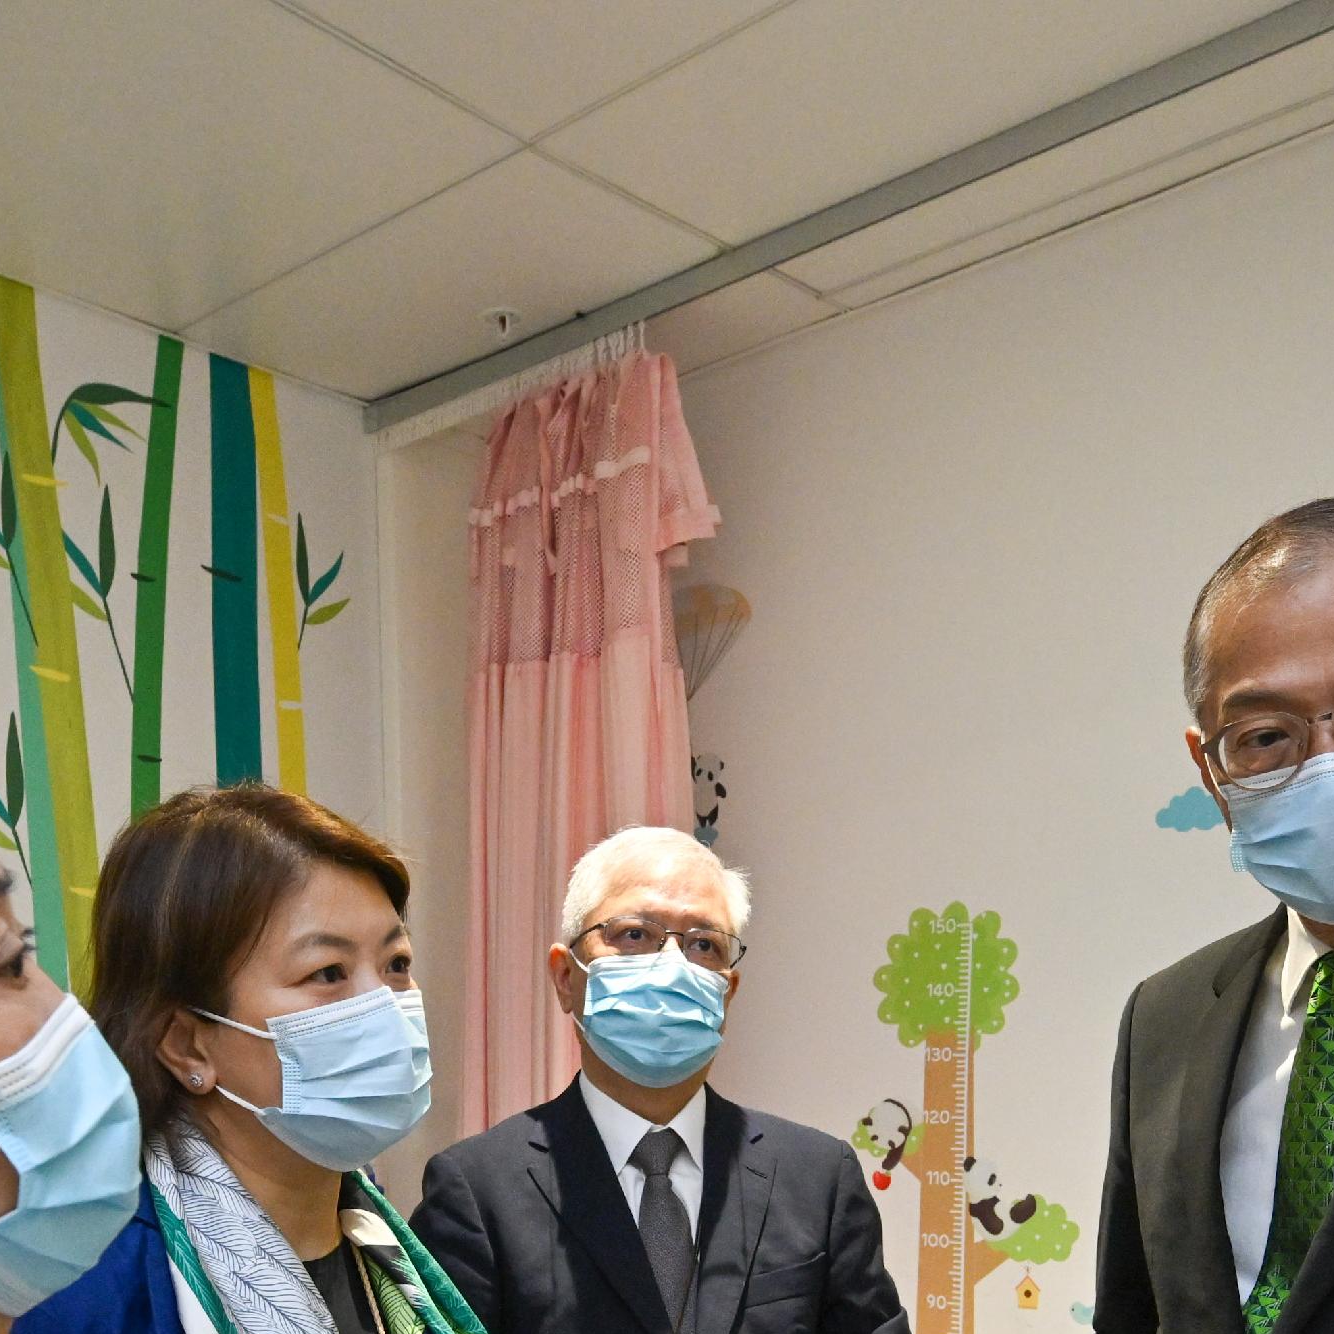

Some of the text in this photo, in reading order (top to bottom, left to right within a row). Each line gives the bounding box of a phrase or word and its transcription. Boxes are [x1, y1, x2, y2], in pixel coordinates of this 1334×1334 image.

[929, 918, 956, 934] 150
[926, 983, 955, 998] 140
[924, 1047, 952, 1062] 130
[923, 1110, 950, 1124] 120
[926, 1171, 950, 1186] 110
[922, 1234, 949, 1248] 100
[926, 1295, 947, 1309] 90
